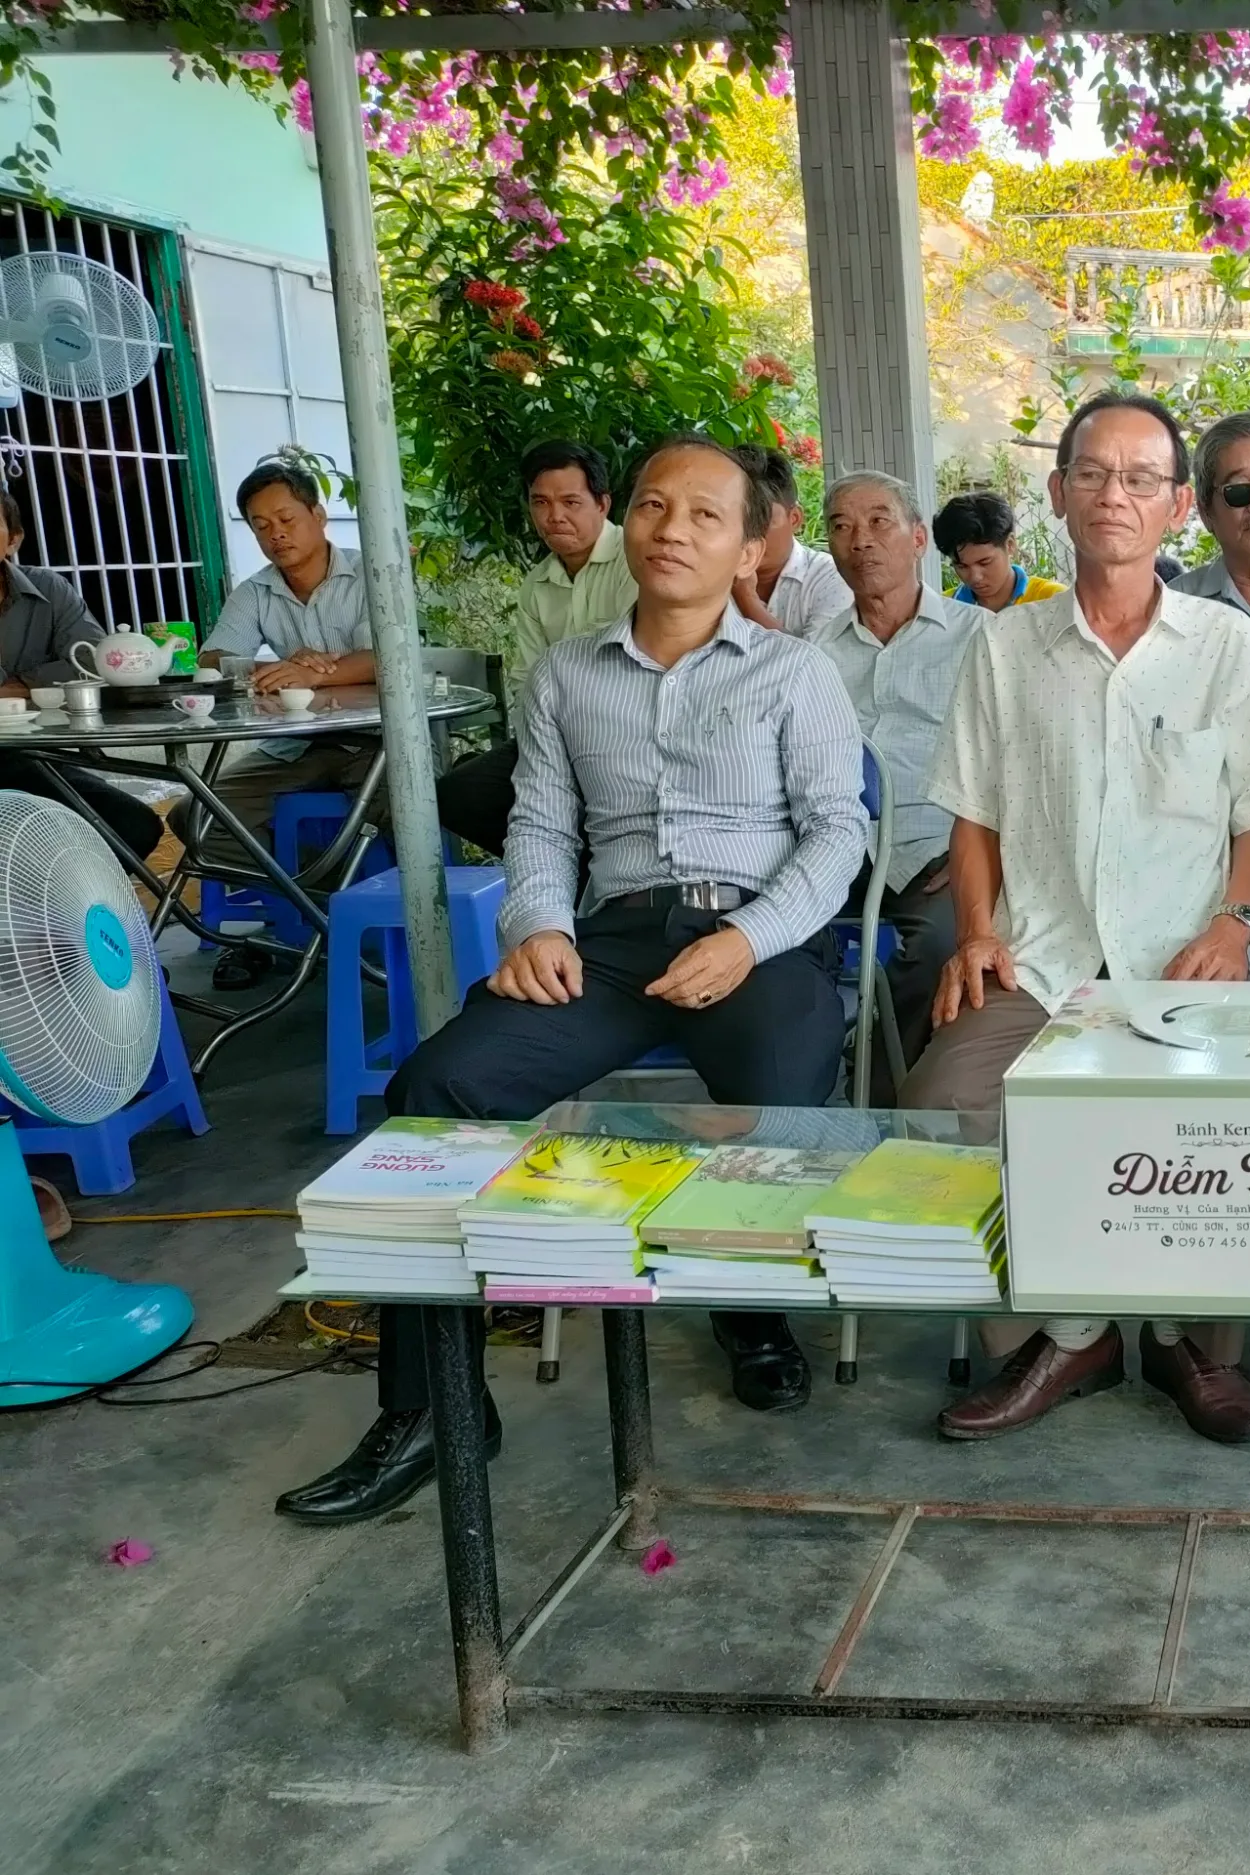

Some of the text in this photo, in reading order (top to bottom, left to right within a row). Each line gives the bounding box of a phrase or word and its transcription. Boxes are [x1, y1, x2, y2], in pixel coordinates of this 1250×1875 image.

[99, 929, 124, 957] SENKO
[1176, 1122, 1217, 1137] Bánh
[1107, 1152, 1234, 1196] Diễm
[1134, 1204, 1170, 1215] Hương
[1177, 1204, 1190, 1215] Vị
[1197, 1203, 1219, 1213] Của
[1115, 1221, 1140, 1232] 24/3
[1147, 1222, 1165, 1231] TT.
[1178, 1237, 1215, 1247] 0967
[1220, 1237, 1247, 1248] 456
